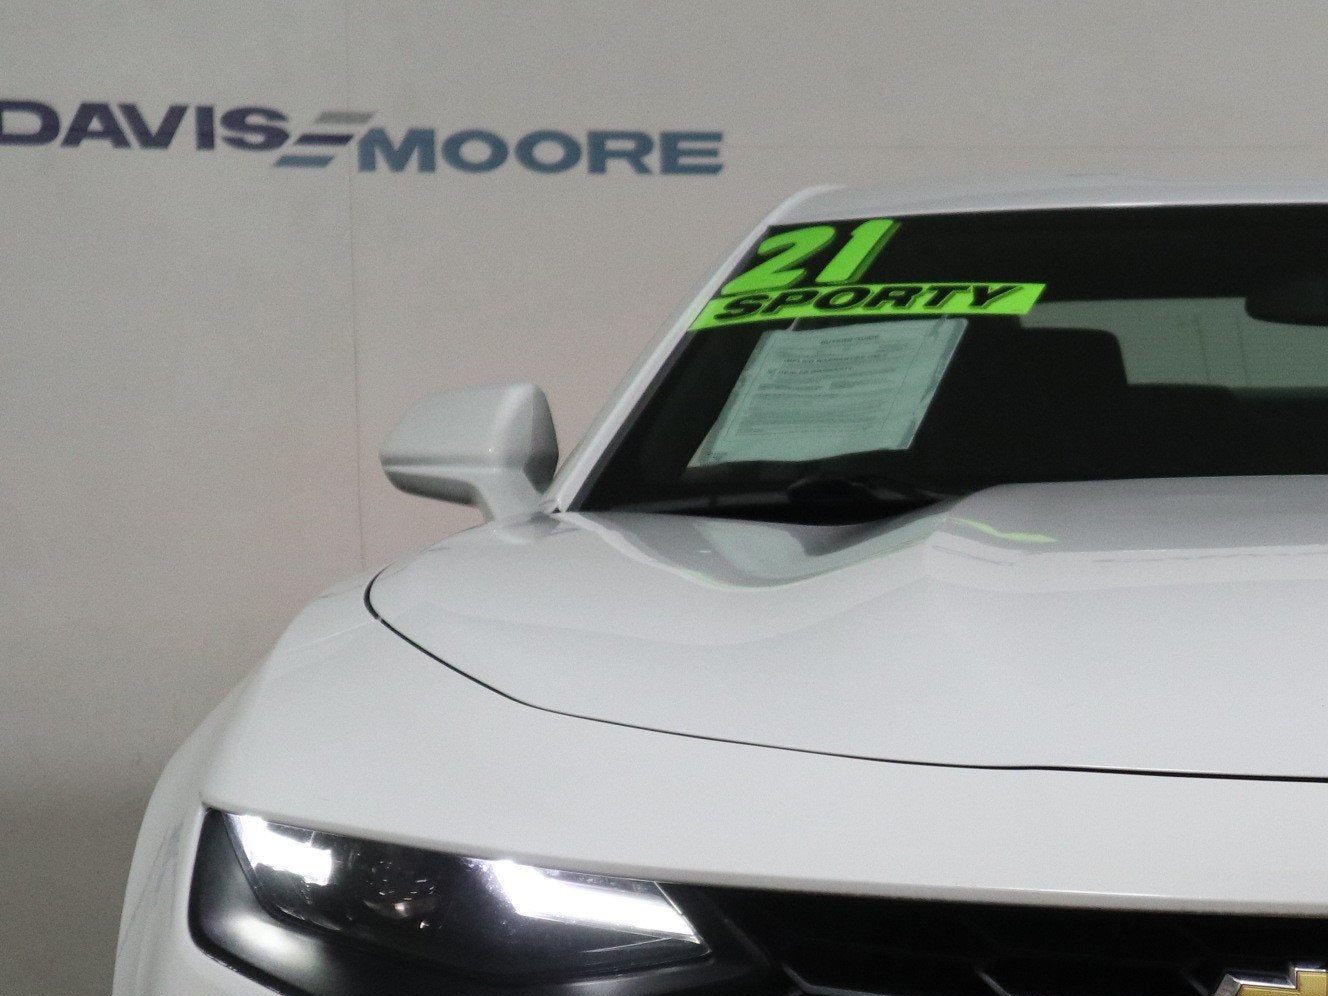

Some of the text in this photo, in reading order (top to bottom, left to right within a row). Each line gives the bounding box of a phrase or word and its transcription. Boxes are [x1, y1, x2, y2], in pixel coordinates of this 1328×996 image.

[0, 99, 725, 176] DAVIS MOORE
[720, 218, 902, 297] 21
[713, 283, 1023, 321] SPORTY
